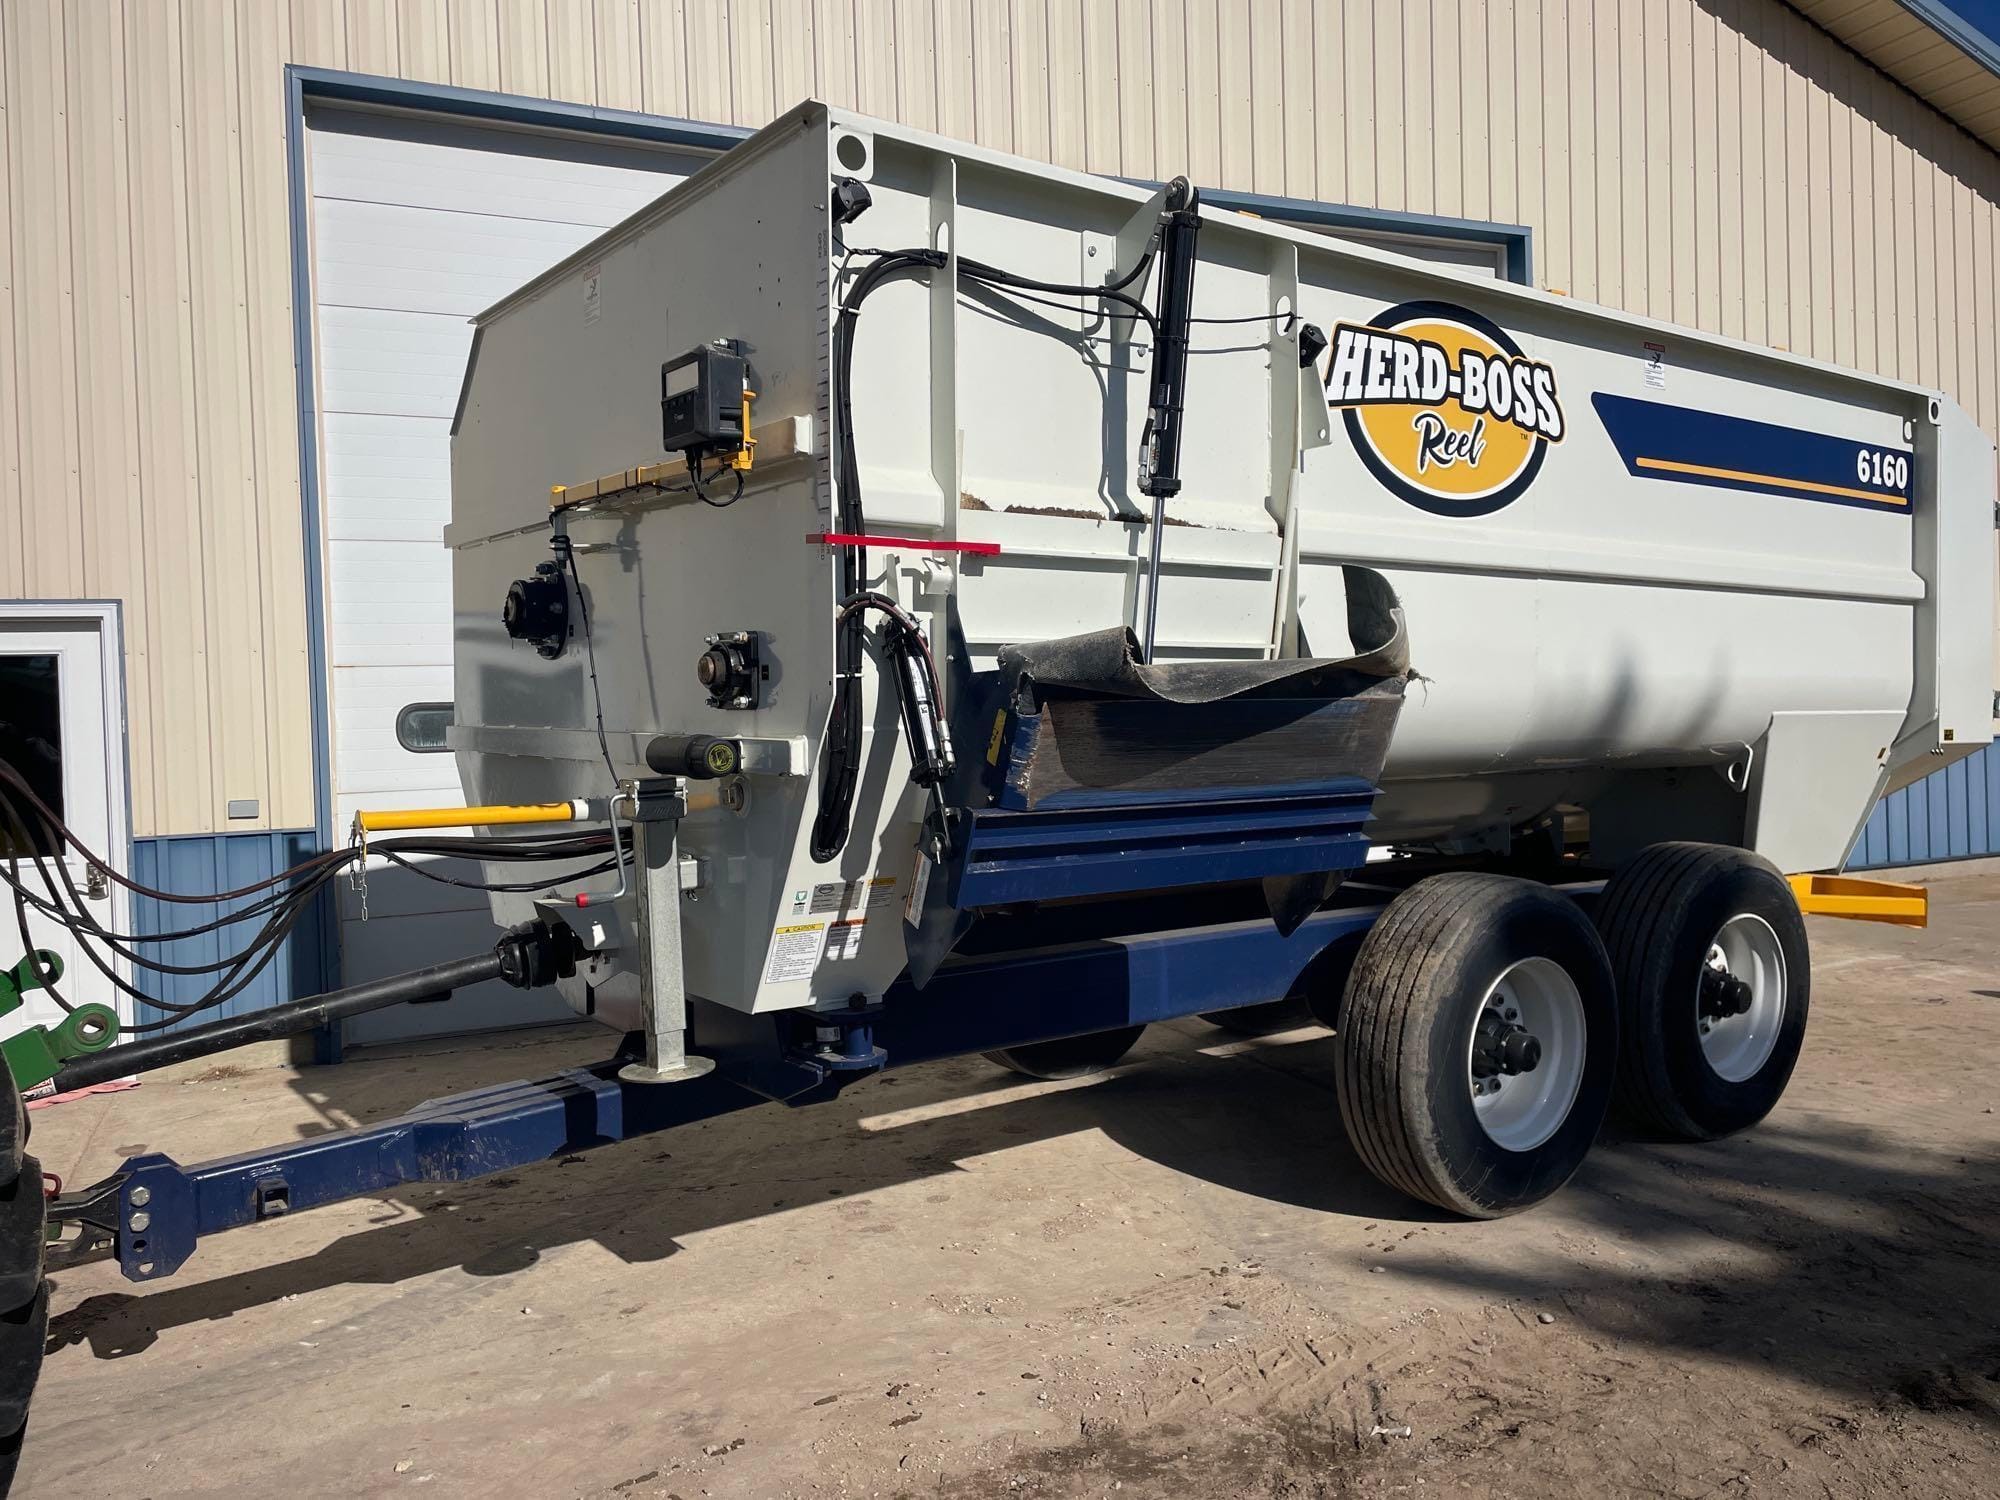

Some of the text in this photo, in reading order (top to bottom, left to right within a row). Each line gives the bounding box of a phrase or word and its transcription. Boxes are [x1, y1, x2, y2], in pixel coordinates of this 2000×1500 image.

[1327, 330, 1561, 437] HERD-BOSS
[1414, 413, 1484, 472] Reel
[1857, 449, 1908, 490] 6160
